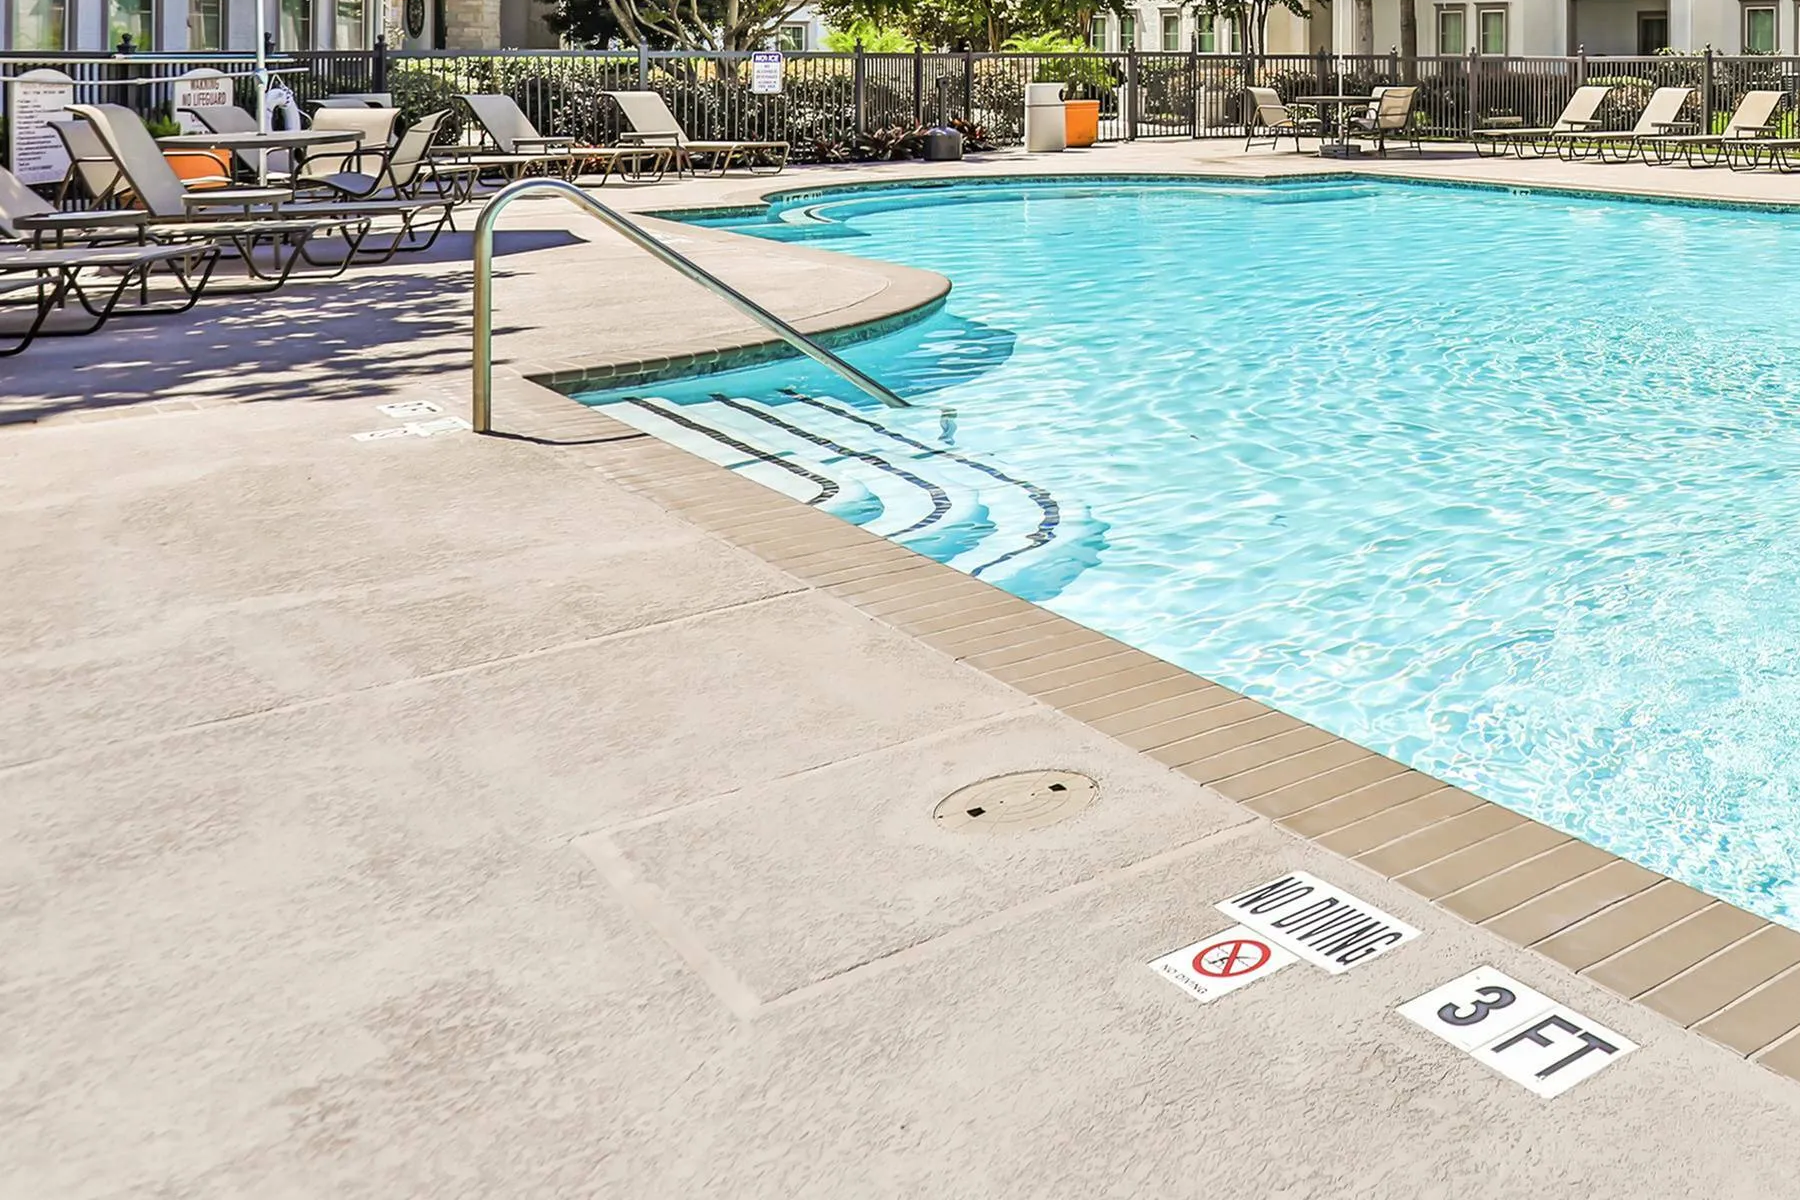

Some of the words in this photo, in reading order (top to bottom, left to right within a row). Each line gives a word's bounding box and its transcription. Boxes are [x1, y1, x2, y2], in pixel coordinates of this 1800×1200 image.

[182, 93, 192, 106] NO
[193, 92, 227, 106] LIFEGUARD
[190, 79, 220, 90] WARNING
[1231, 877, 1315, 915] NO
[1270, 897, 1403, 965] DIVING
[1163, 963, 1178, 974] NO
[1174, 972, 1208, 995] DIVING
[1437, 985, 1517, 1026] 3
[1490, 1014, 1621, 1079] FT
